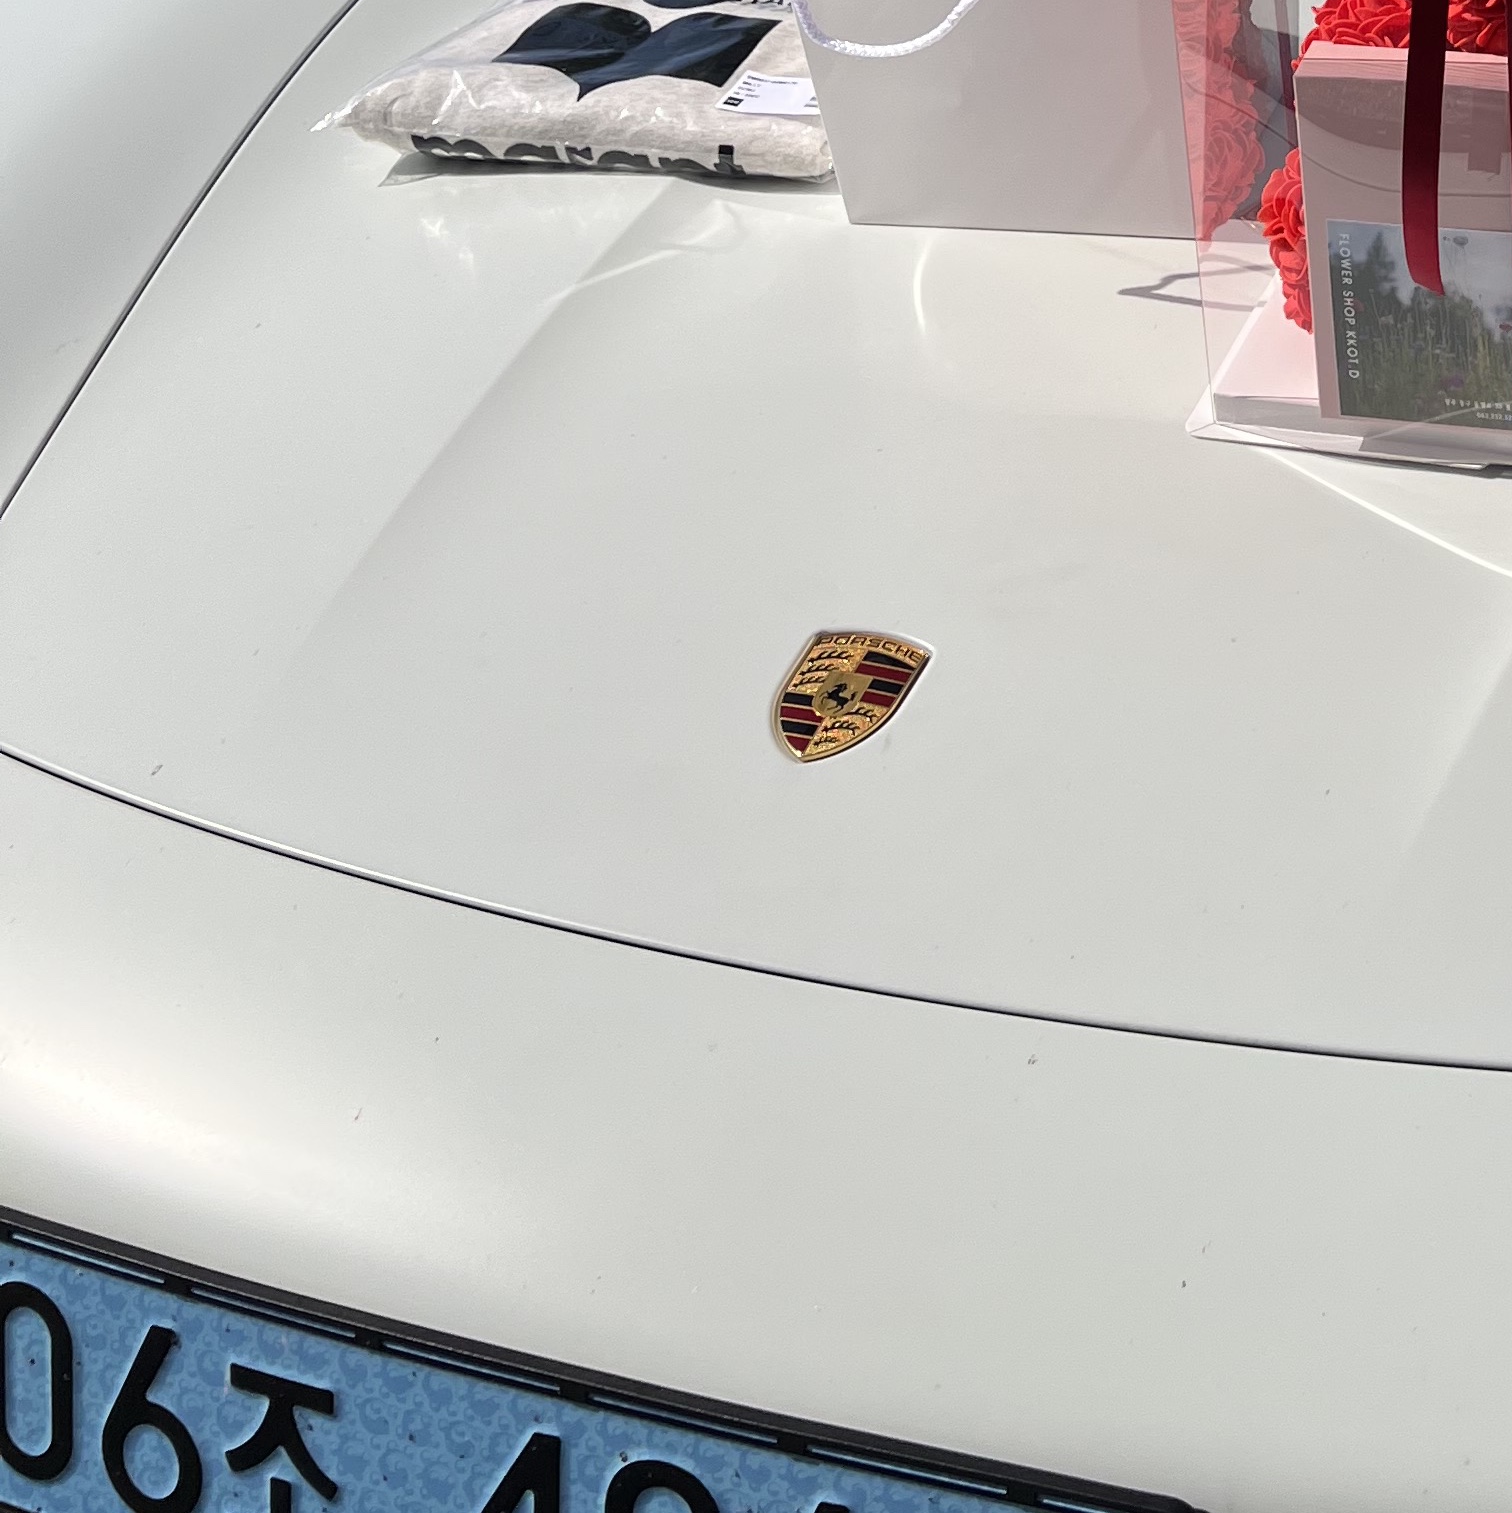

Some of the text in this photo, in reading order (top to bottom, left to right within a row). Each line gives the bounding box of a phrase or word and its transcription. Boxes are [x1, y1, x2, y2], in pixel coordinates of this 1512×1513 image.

[1338, 233, 1361, 379] FLOWER SHOP KKOT.D
[820, 636, 924, 663] PORSCHE
